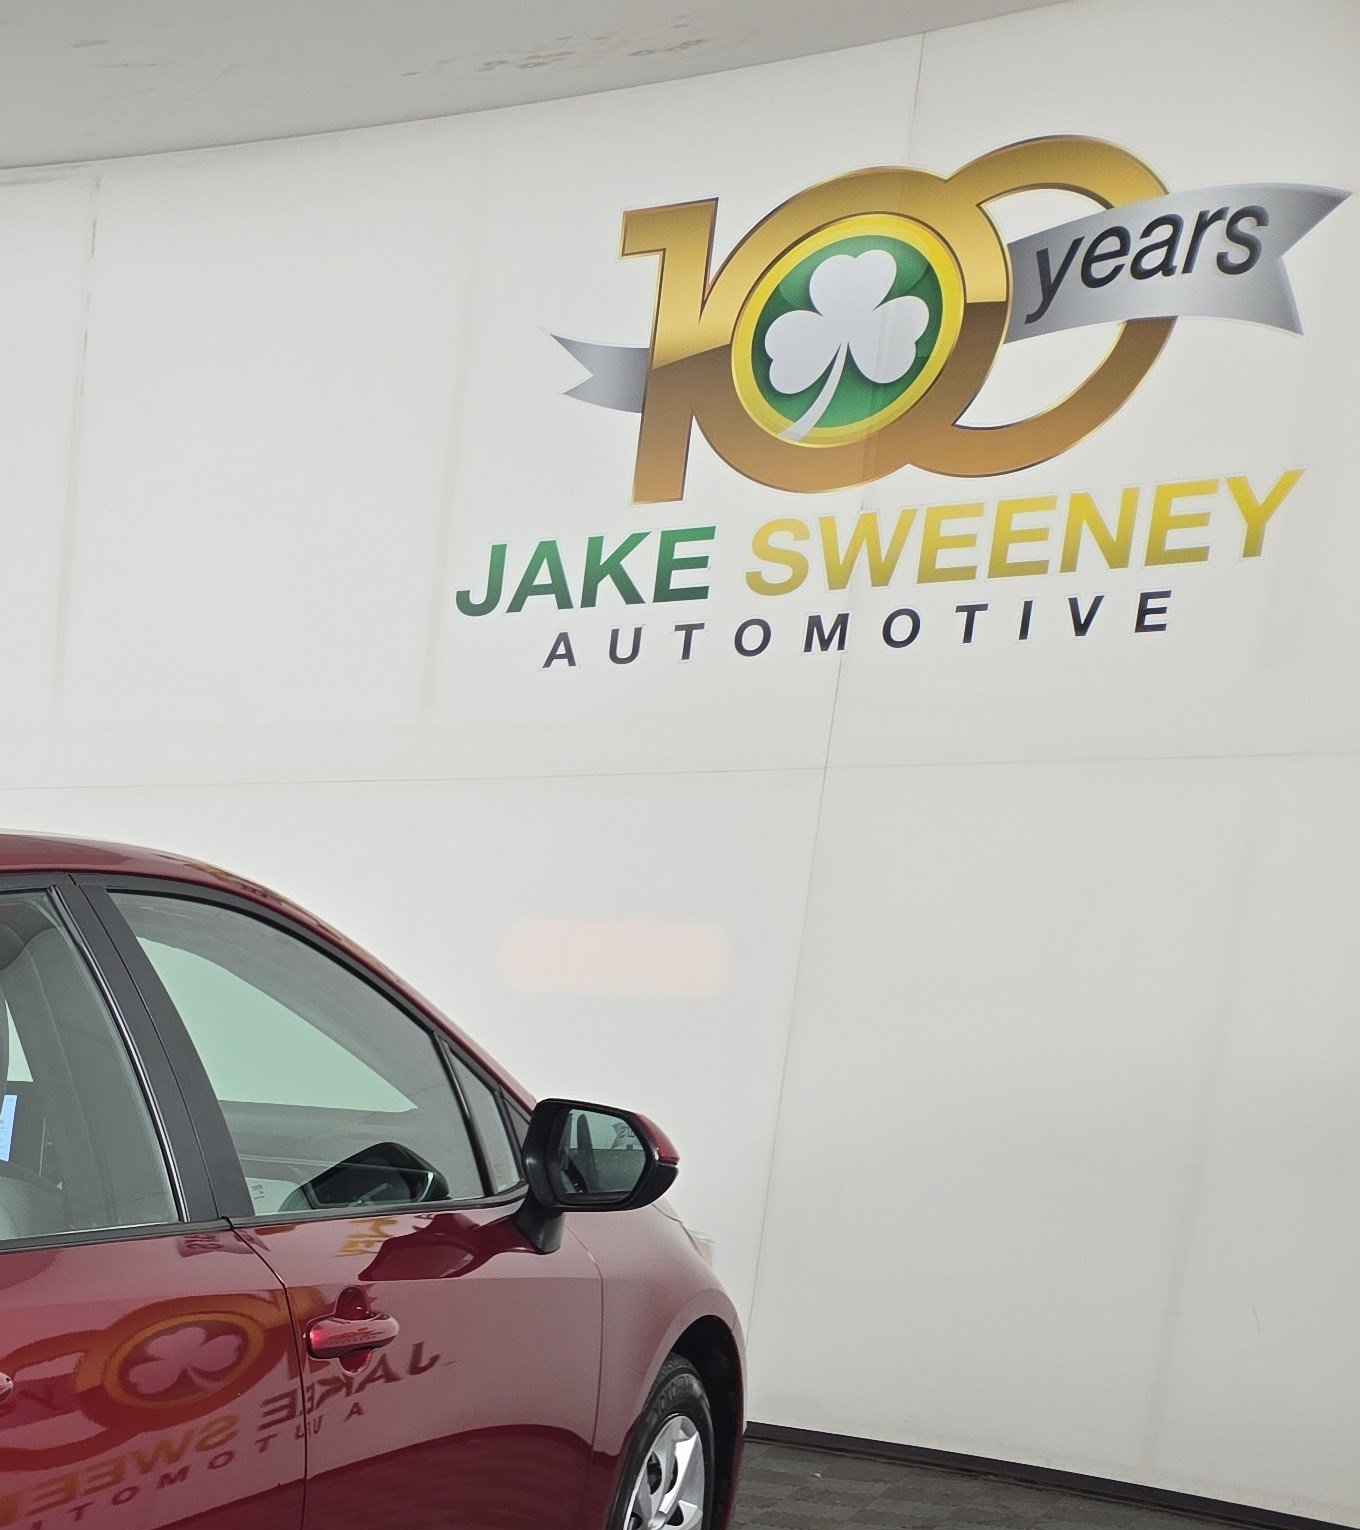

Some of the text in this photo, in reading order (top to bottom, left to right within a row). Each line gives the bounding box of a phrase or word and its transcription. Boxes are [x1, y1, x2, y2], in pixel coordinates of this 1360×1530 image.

[1025, 205, 1269, 325] years
[456, 469, 1304, 617] JAKE SWEENEY
[543, 590, 1171, 668] AUTOMOTIVE
